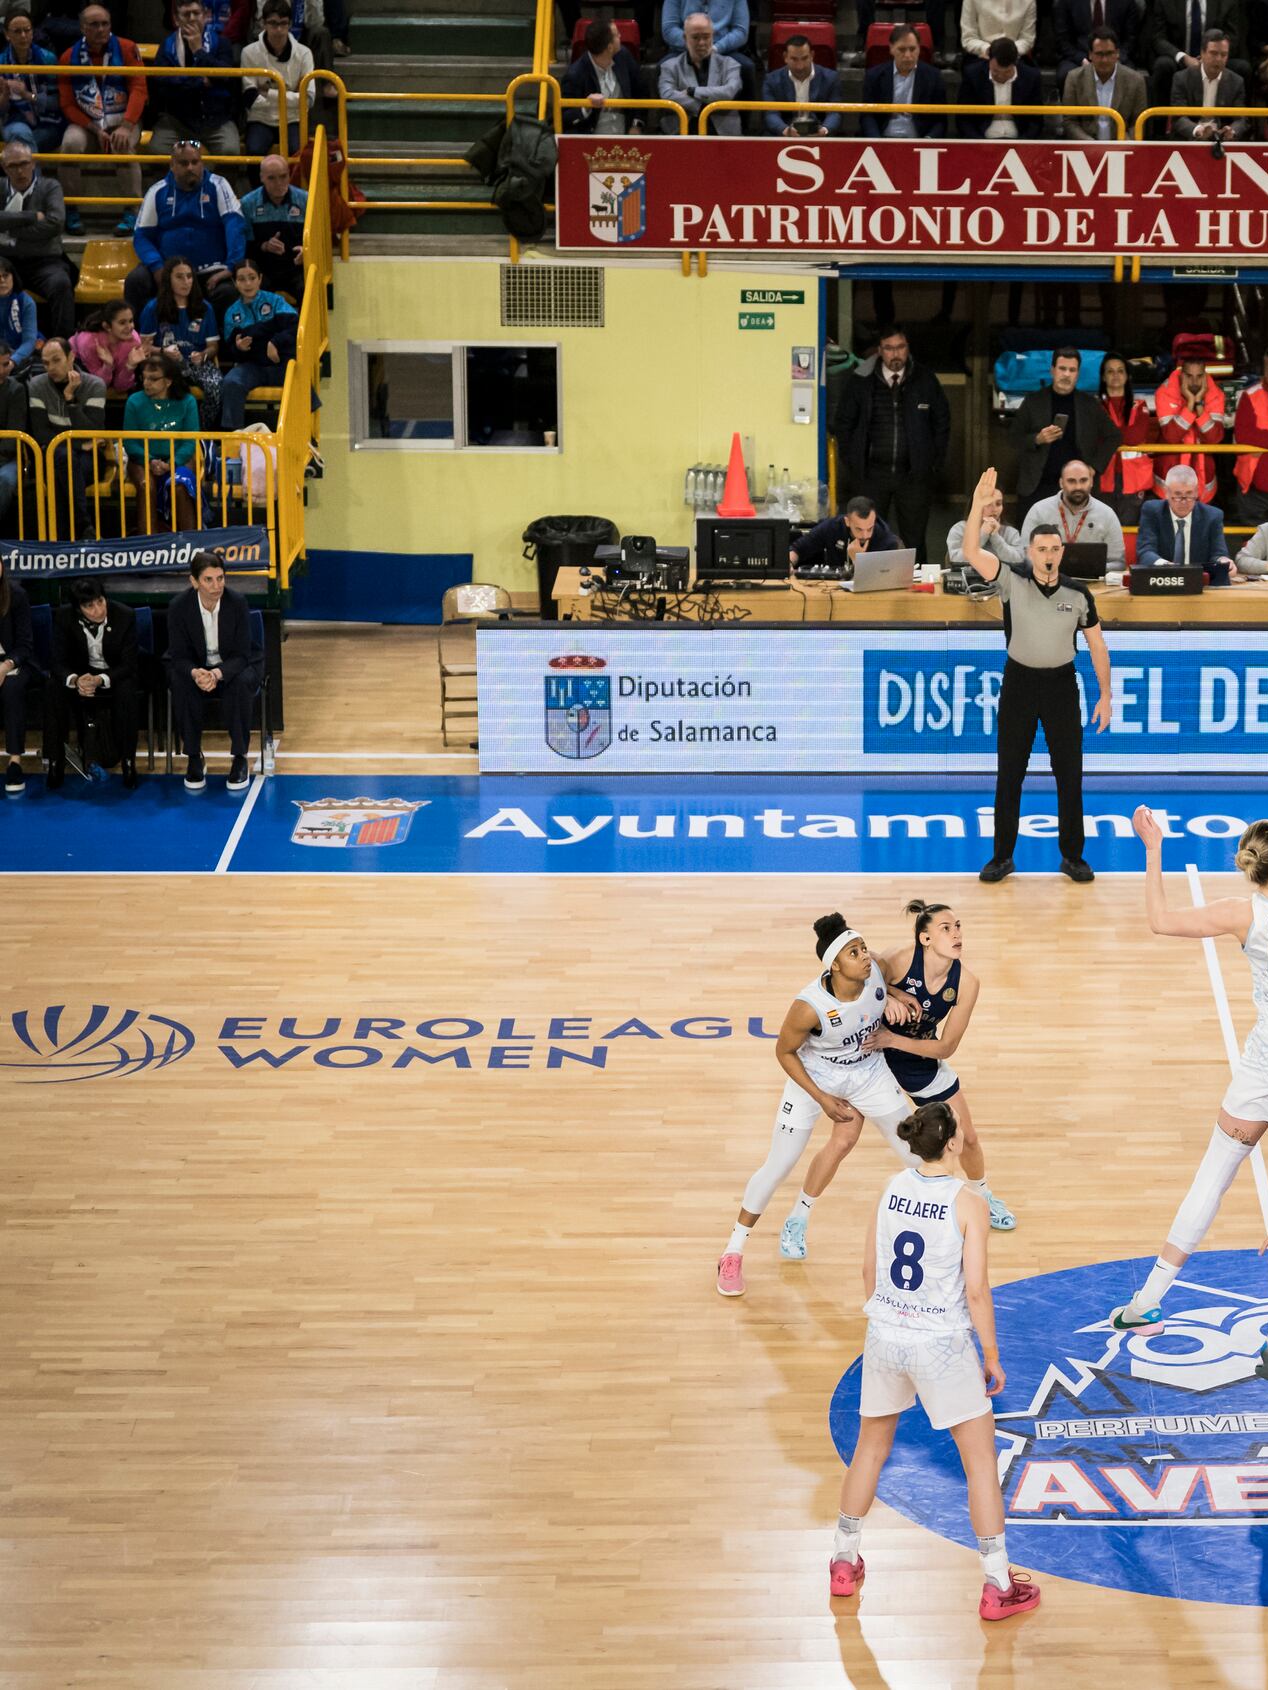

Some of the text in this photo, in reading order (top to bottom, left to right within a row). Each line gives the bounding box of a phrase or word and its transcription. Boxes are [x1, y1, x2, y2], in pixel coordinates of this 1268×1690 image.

[669, 203, 1005, 246] PATRIMONIO
[1022, 207, 1096, 247] DE
[1114, 208, 1179, 248] LA
[745, 291, 783, 302] SALIDA
[1149, 576, 1185, 586] POSSE
[618, 674, 752, 702] Diputación
[1110, 667, 1180, 734] EL
[618, 720, 777, 742] de Salamanca
[217, 1045, 608, 1069] WOMEN
[888, 1194, 948, 1220] DELAERE
[890, 1230, 925, 1292] 8
